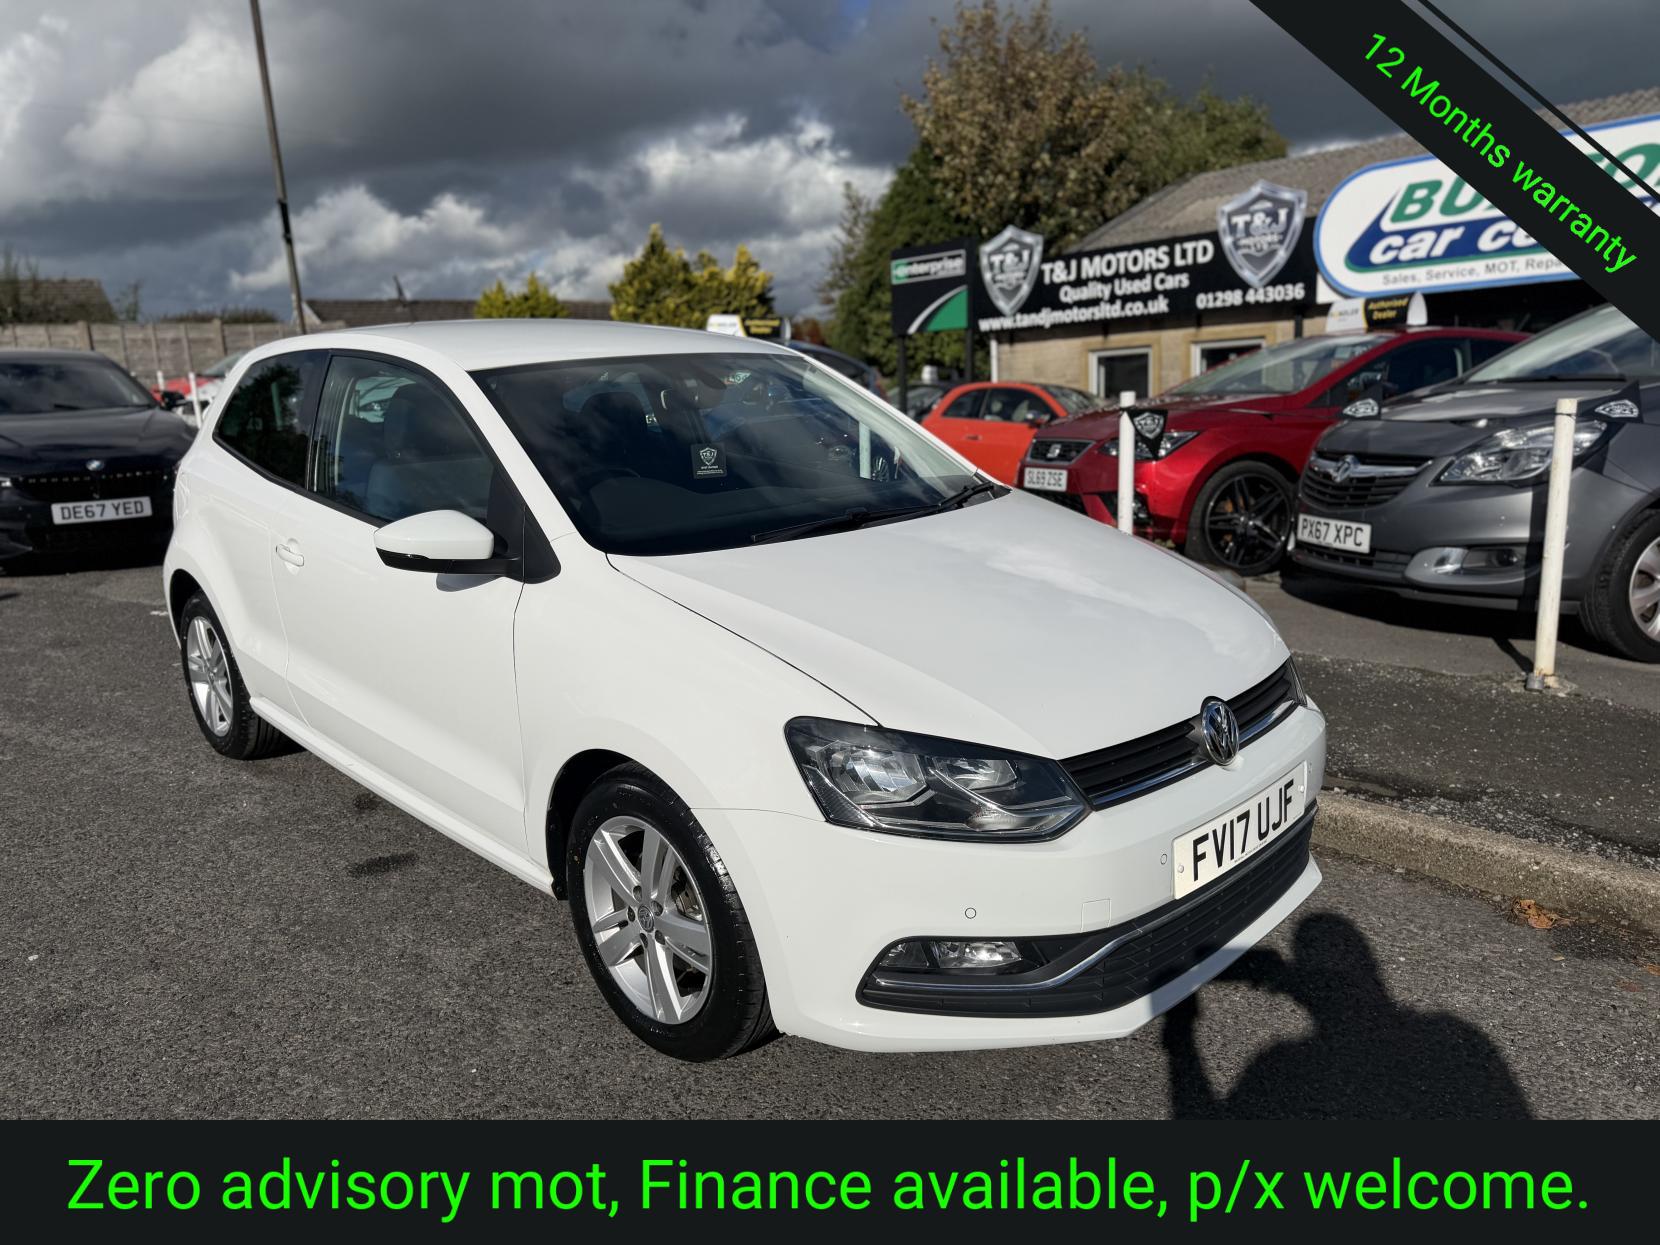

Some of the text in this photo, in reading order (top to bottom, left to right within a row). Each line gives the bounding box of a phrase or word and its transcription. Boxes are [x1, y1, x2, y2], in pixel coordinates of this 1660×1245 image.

[1231, 207, 1290, 238] T&J
[1369, 226, 1466, 264] car
[1041, 258, 1078, 285] T&J
[1081, 245, 1170, 279] MOTORS
[1174, 239, 1215, 267] LTD
[1382, 256, 1564, 286] Sales, Service, MOT, Repa
[1059, 272, 1191, 304] Quality Used Cars
[1196, 282, 1306, 309] 01298 443036
[978, 294, 1169, 332] www.tandjmotorsltd.co.uk
[60, 500, 145, 521] DE67 YED
[1301, 518, 1364, 547] PX67 XPC
[1192, 778, 1295, 882] FV17 UJF
